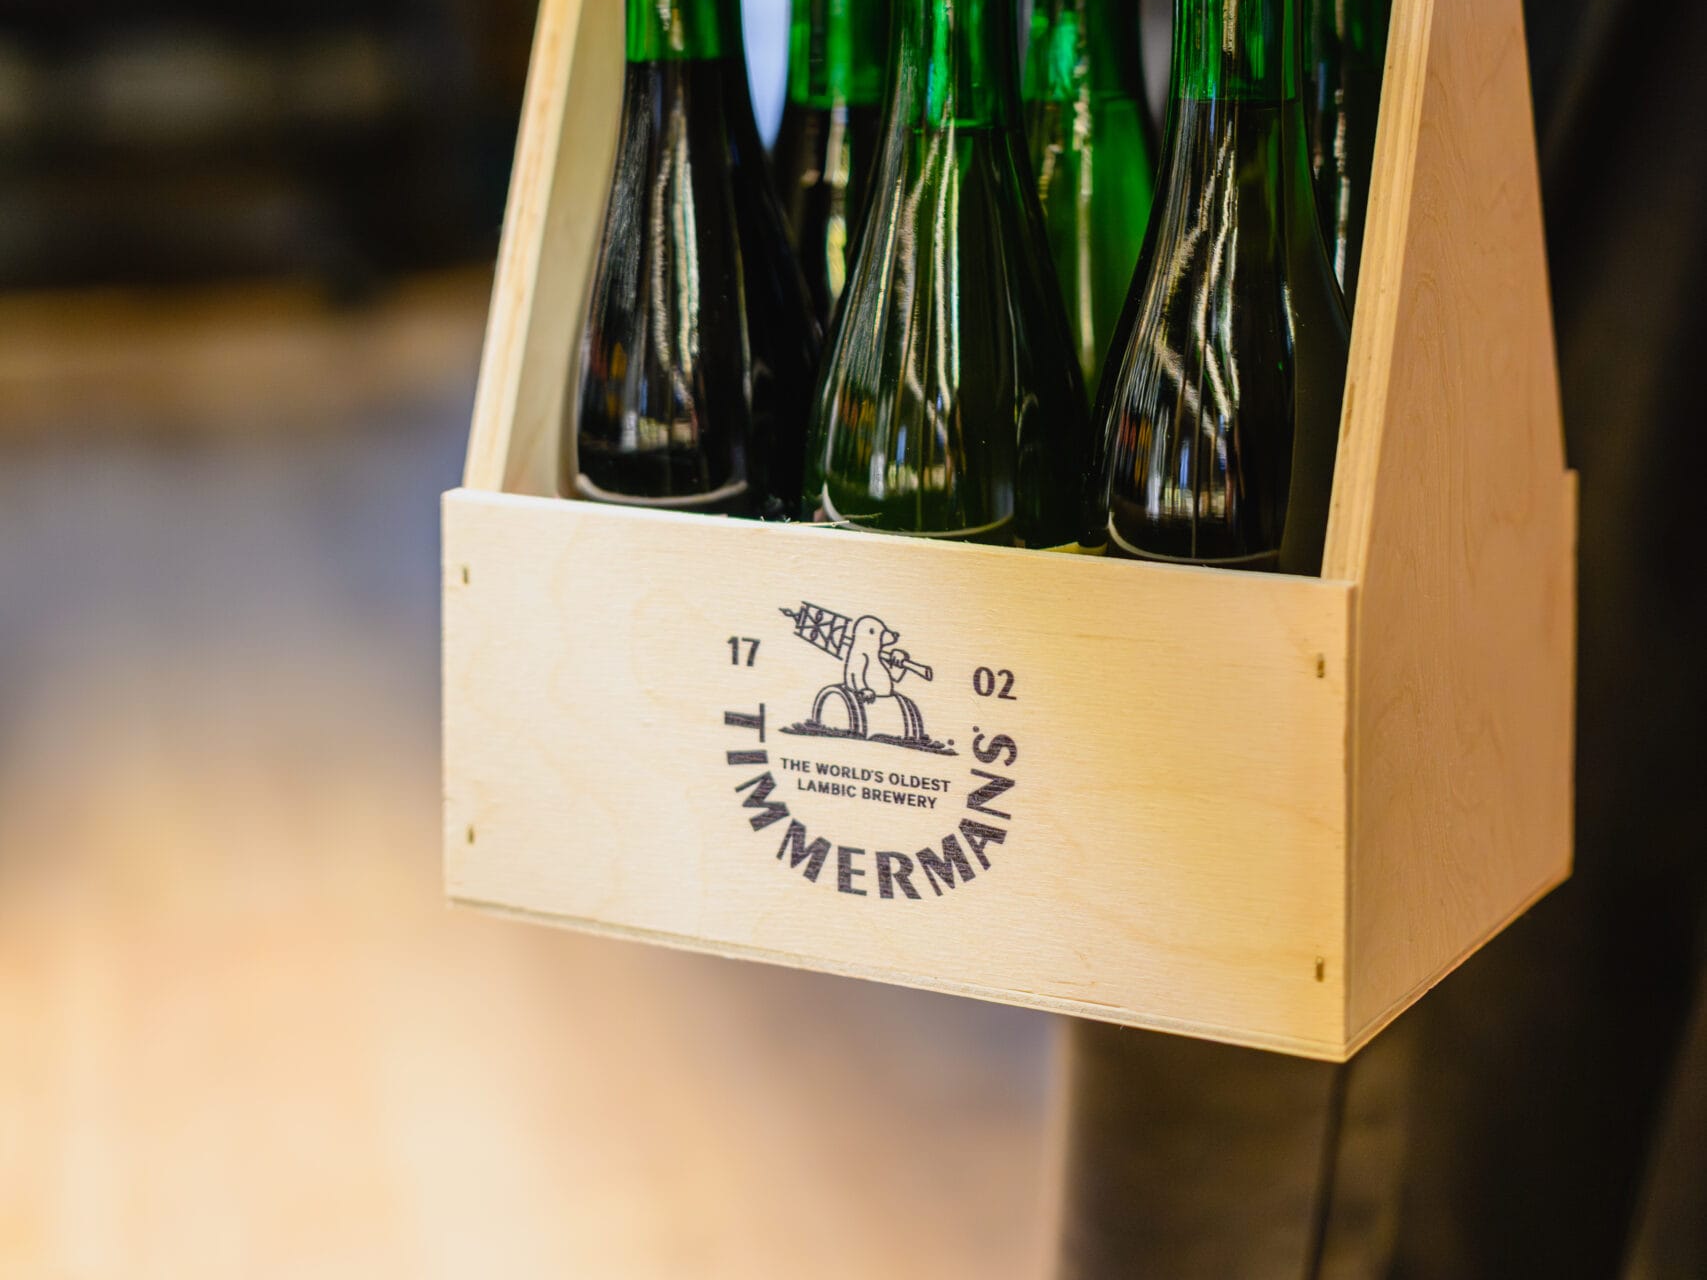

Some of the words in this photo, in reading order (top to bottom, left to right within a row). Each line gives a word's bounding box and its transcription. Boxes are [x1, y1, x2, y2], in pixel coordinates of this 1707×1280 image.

[726, 635, 761, 667] 17
[972, 666, 1018, 701] 02
[780, 757, 811, 774] THE
[815, 762, 885, 784] WORLD'S
[888, 772, 952, 793] OLDEST
[797, 777, 857, 799] LAMBIC
[861, 786, 938, 810] BREWERY
